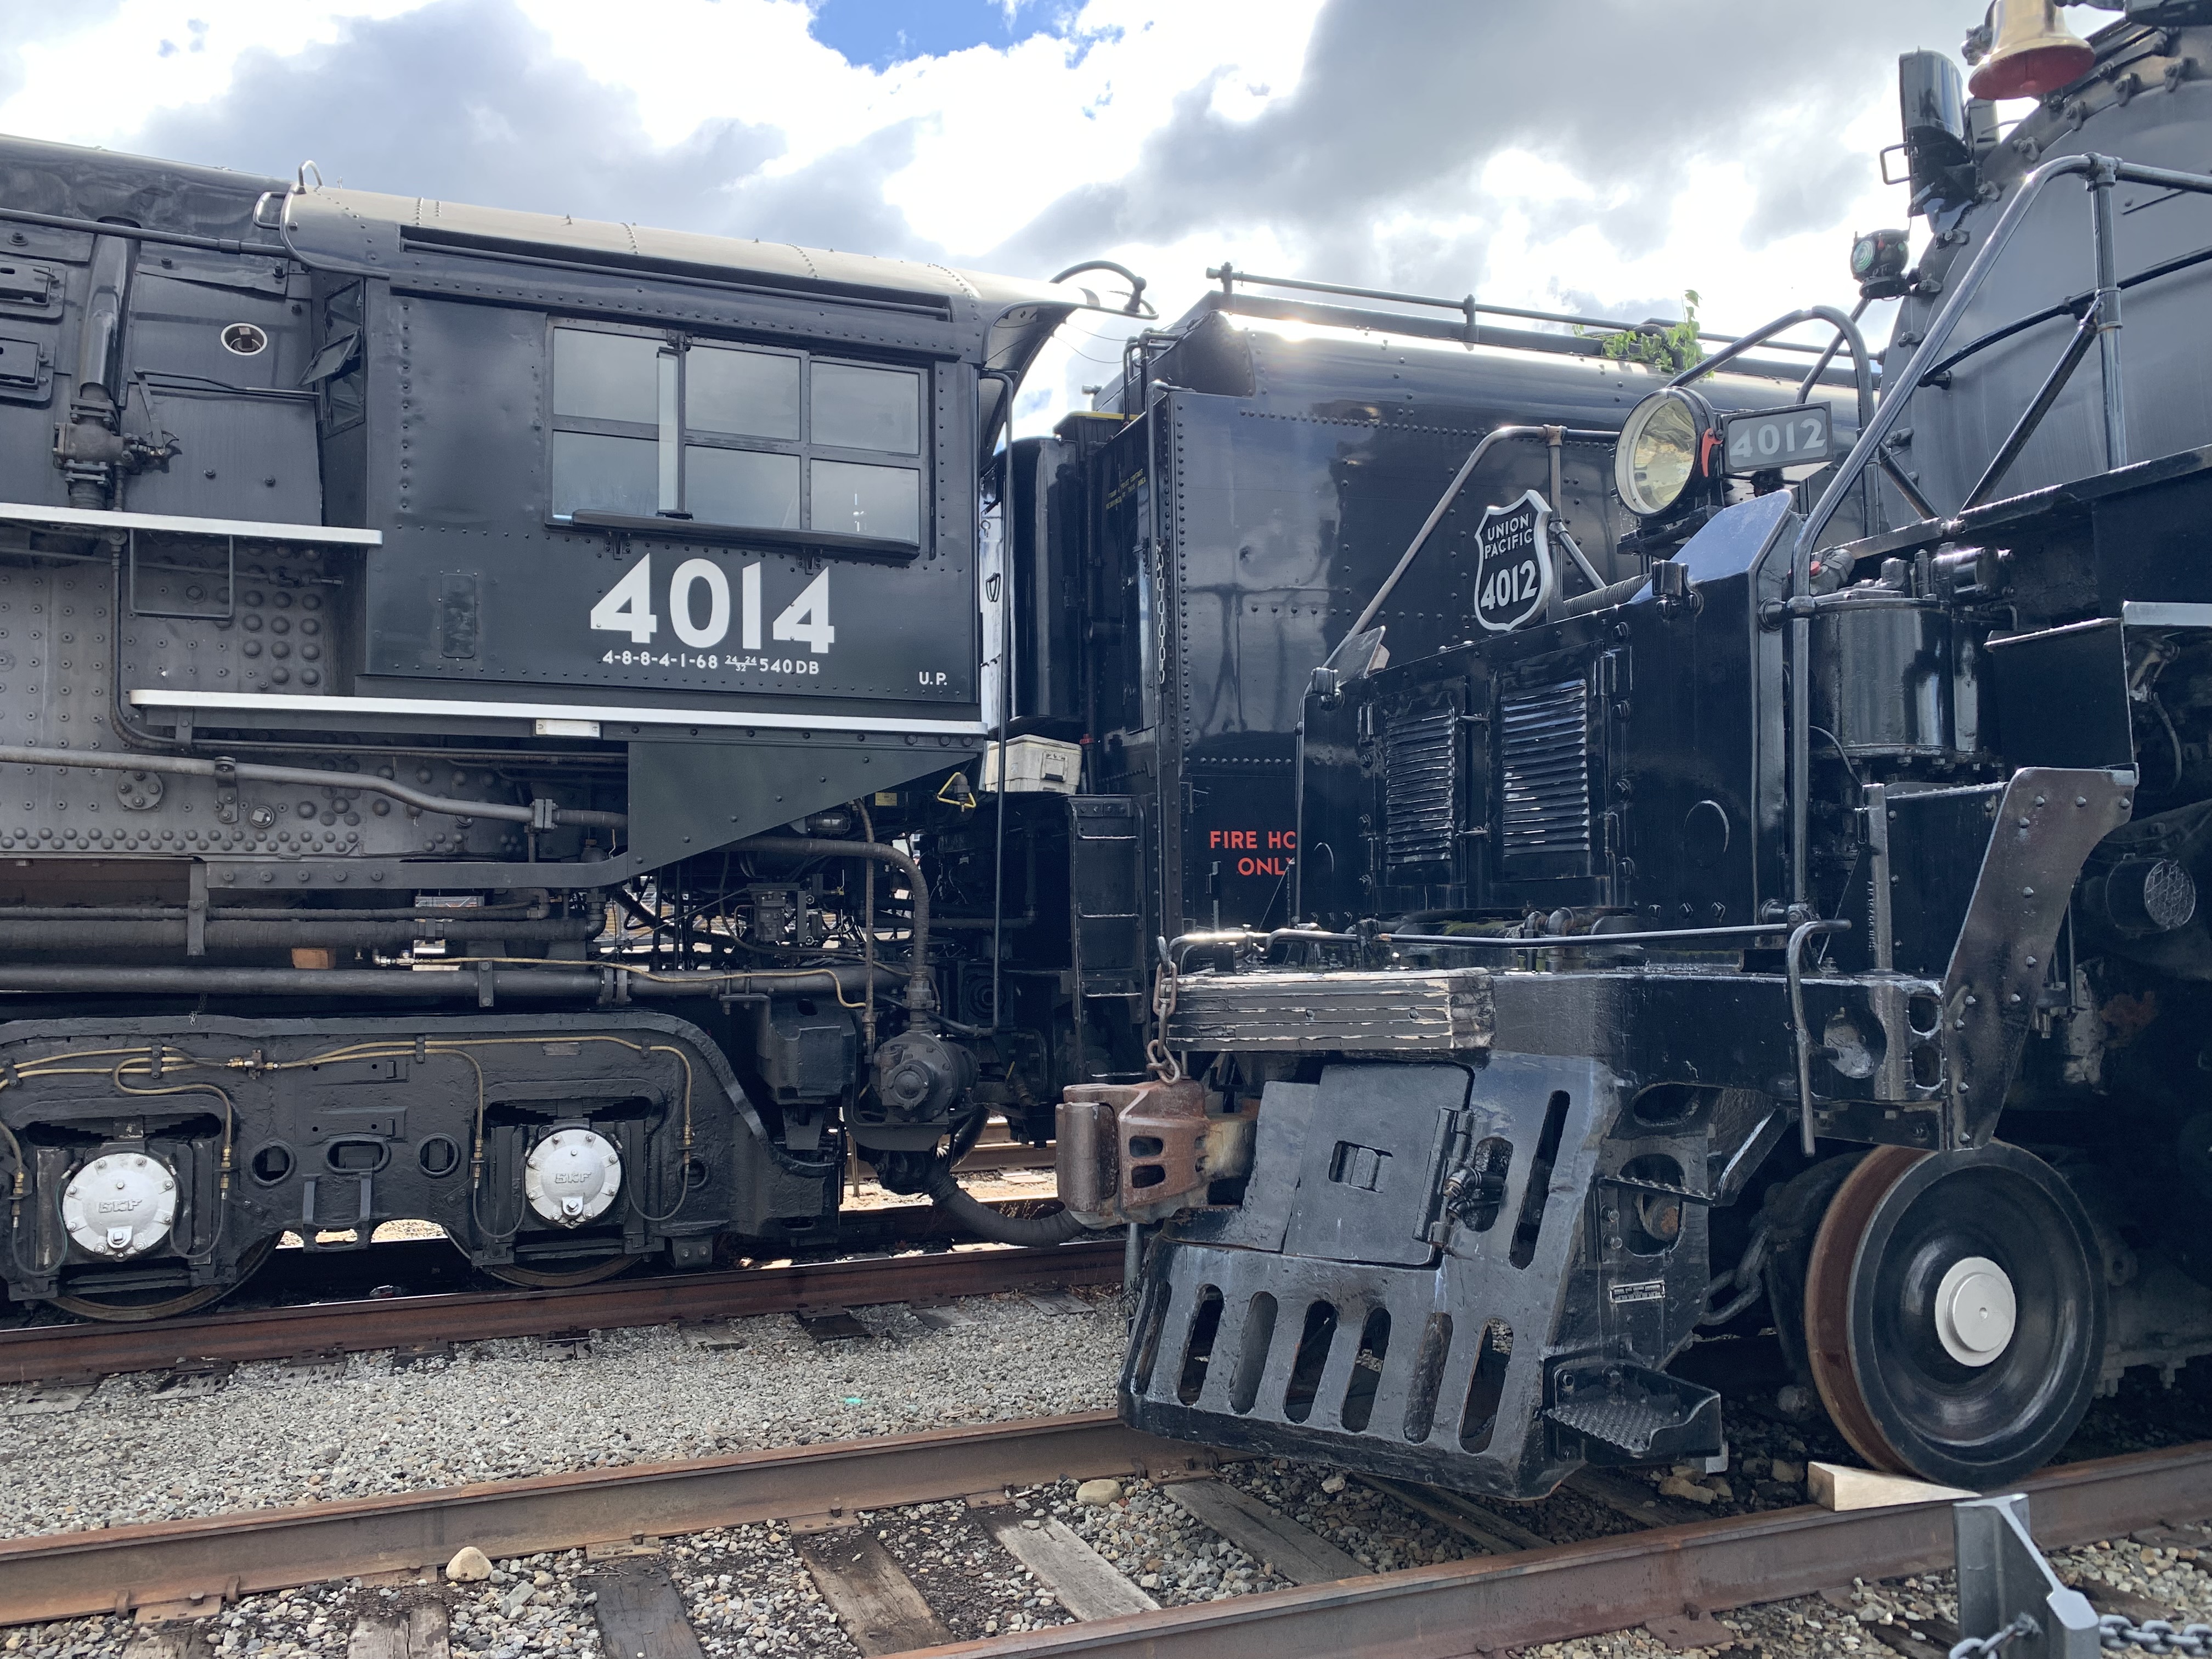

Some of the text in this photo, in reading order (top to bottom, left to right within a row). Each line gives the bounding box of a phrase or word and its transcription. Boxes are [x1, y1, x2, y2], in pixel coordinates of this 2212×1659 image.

[1729, 417, 1826, 458] 4012
[1487, 512, 1530, 541] UNION
[1485, 528, 1533, 559] PACIFIC
[1480, 560, 1538, 610] 4012
[590, 552, 835, 653] 4014
[602, 650, 718, 669] 4-8-8-4-1-68
[919, 671, 947, 686] U.P.
[1210, 831, 1258, 849] FIRE
[1238, 857, 1292, 876] ONL
[555, 1172, 592, 1184] SKF
[99, 1199, 143, 1213] SKF
